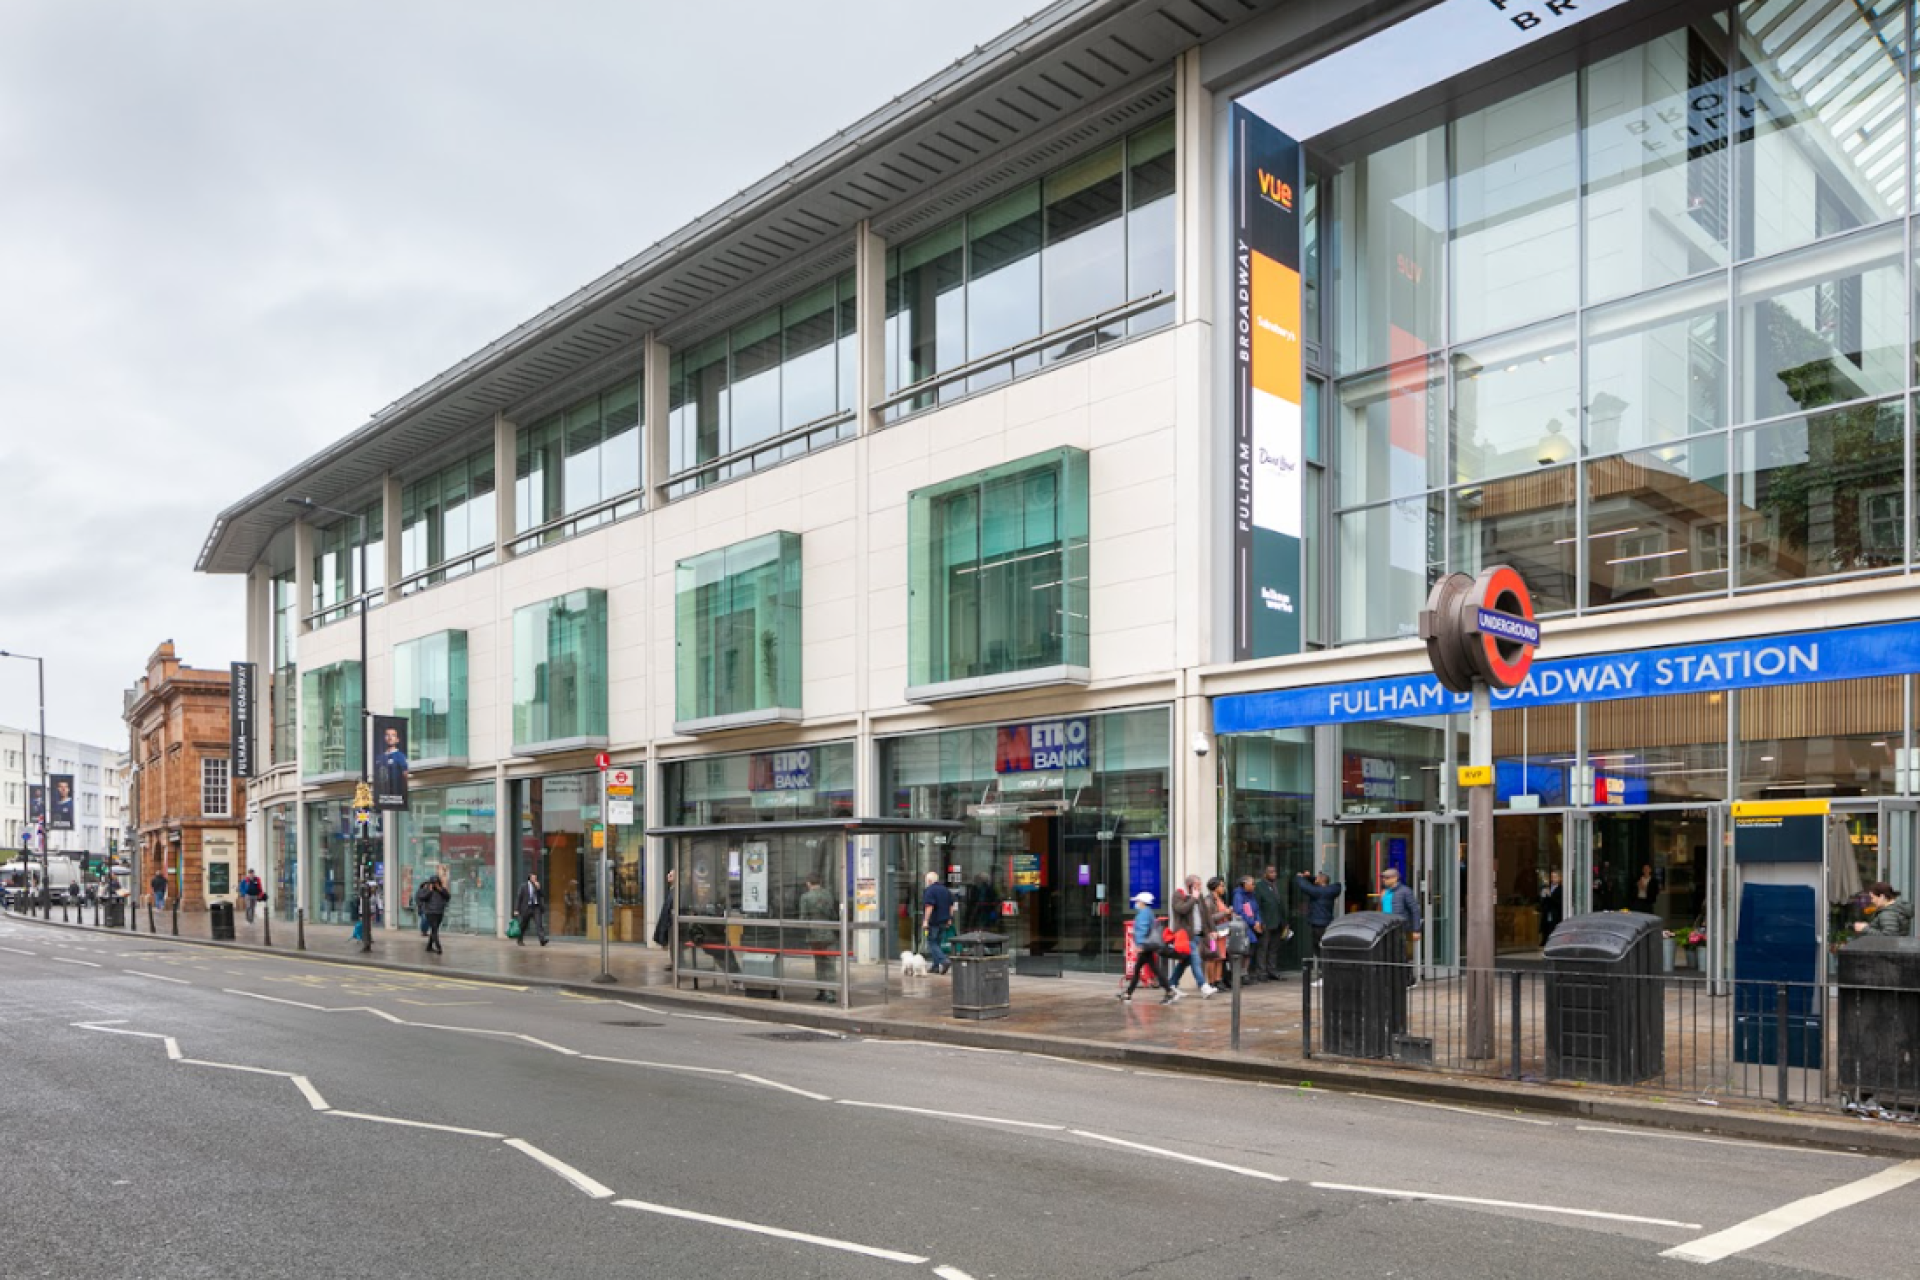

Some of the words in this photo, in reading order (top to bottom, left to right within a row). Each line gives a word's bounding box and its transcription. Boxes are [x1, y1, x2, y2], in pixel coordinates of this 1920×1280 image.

[1239, 239, 1249, 362] BROADWAY
[1239, 442, 1250, 532] FULHAM
[1479, 611, 1538, 642] UNDERGROUND
[237, 664, 247, 720] BROADWAY
[1329, 683, 1443, 715] FULHAM
[1655, 643, 1818, 686] STATION
[237, 735, 247, 775] FULHAM
[600, 753, 608, 766] L
[1034, 748, 1087, 769] BANK
[1464, 770, 1483, 779] RVP
